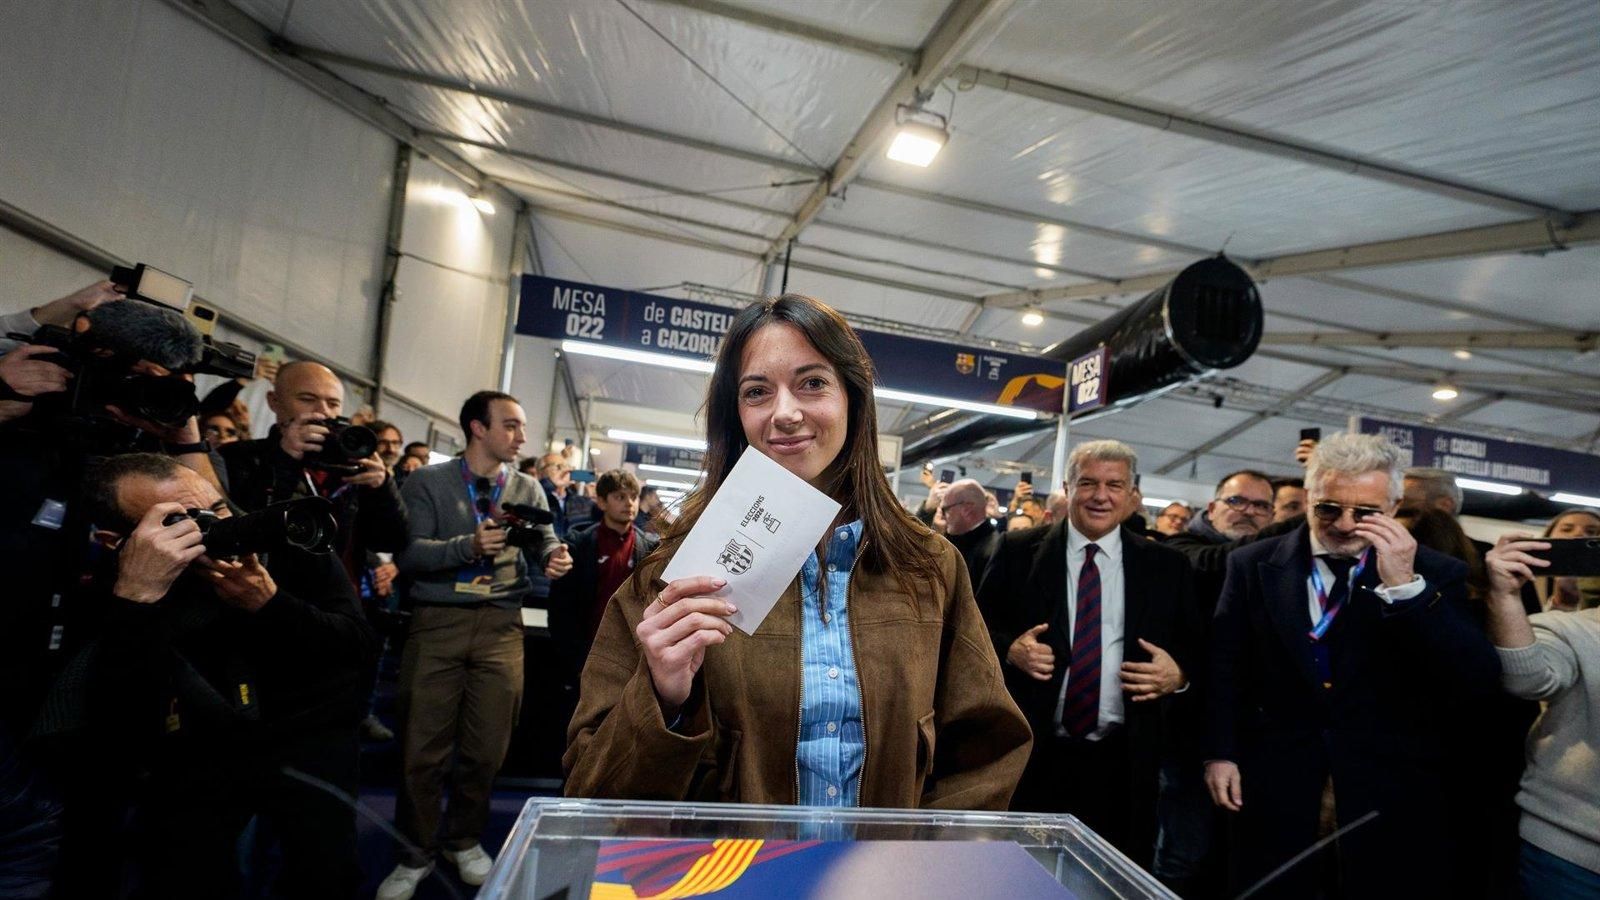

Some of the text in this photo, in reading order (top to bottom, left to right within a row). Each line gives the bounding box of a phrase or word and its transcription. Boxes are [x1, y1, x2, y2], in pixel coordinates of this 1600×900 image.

[552, 286, 606, 317] MESA
[644, 302, 665, 325] de
[565, 315, 606, 340] 022
[641, 329, 651, 346] a
[1072, 354, 1101, 386] MESA
[1077, 378, 1101, 405] 022
[741, 495, 764, 527] ELECCIONS
[753, 508, 764, 521] 2026
